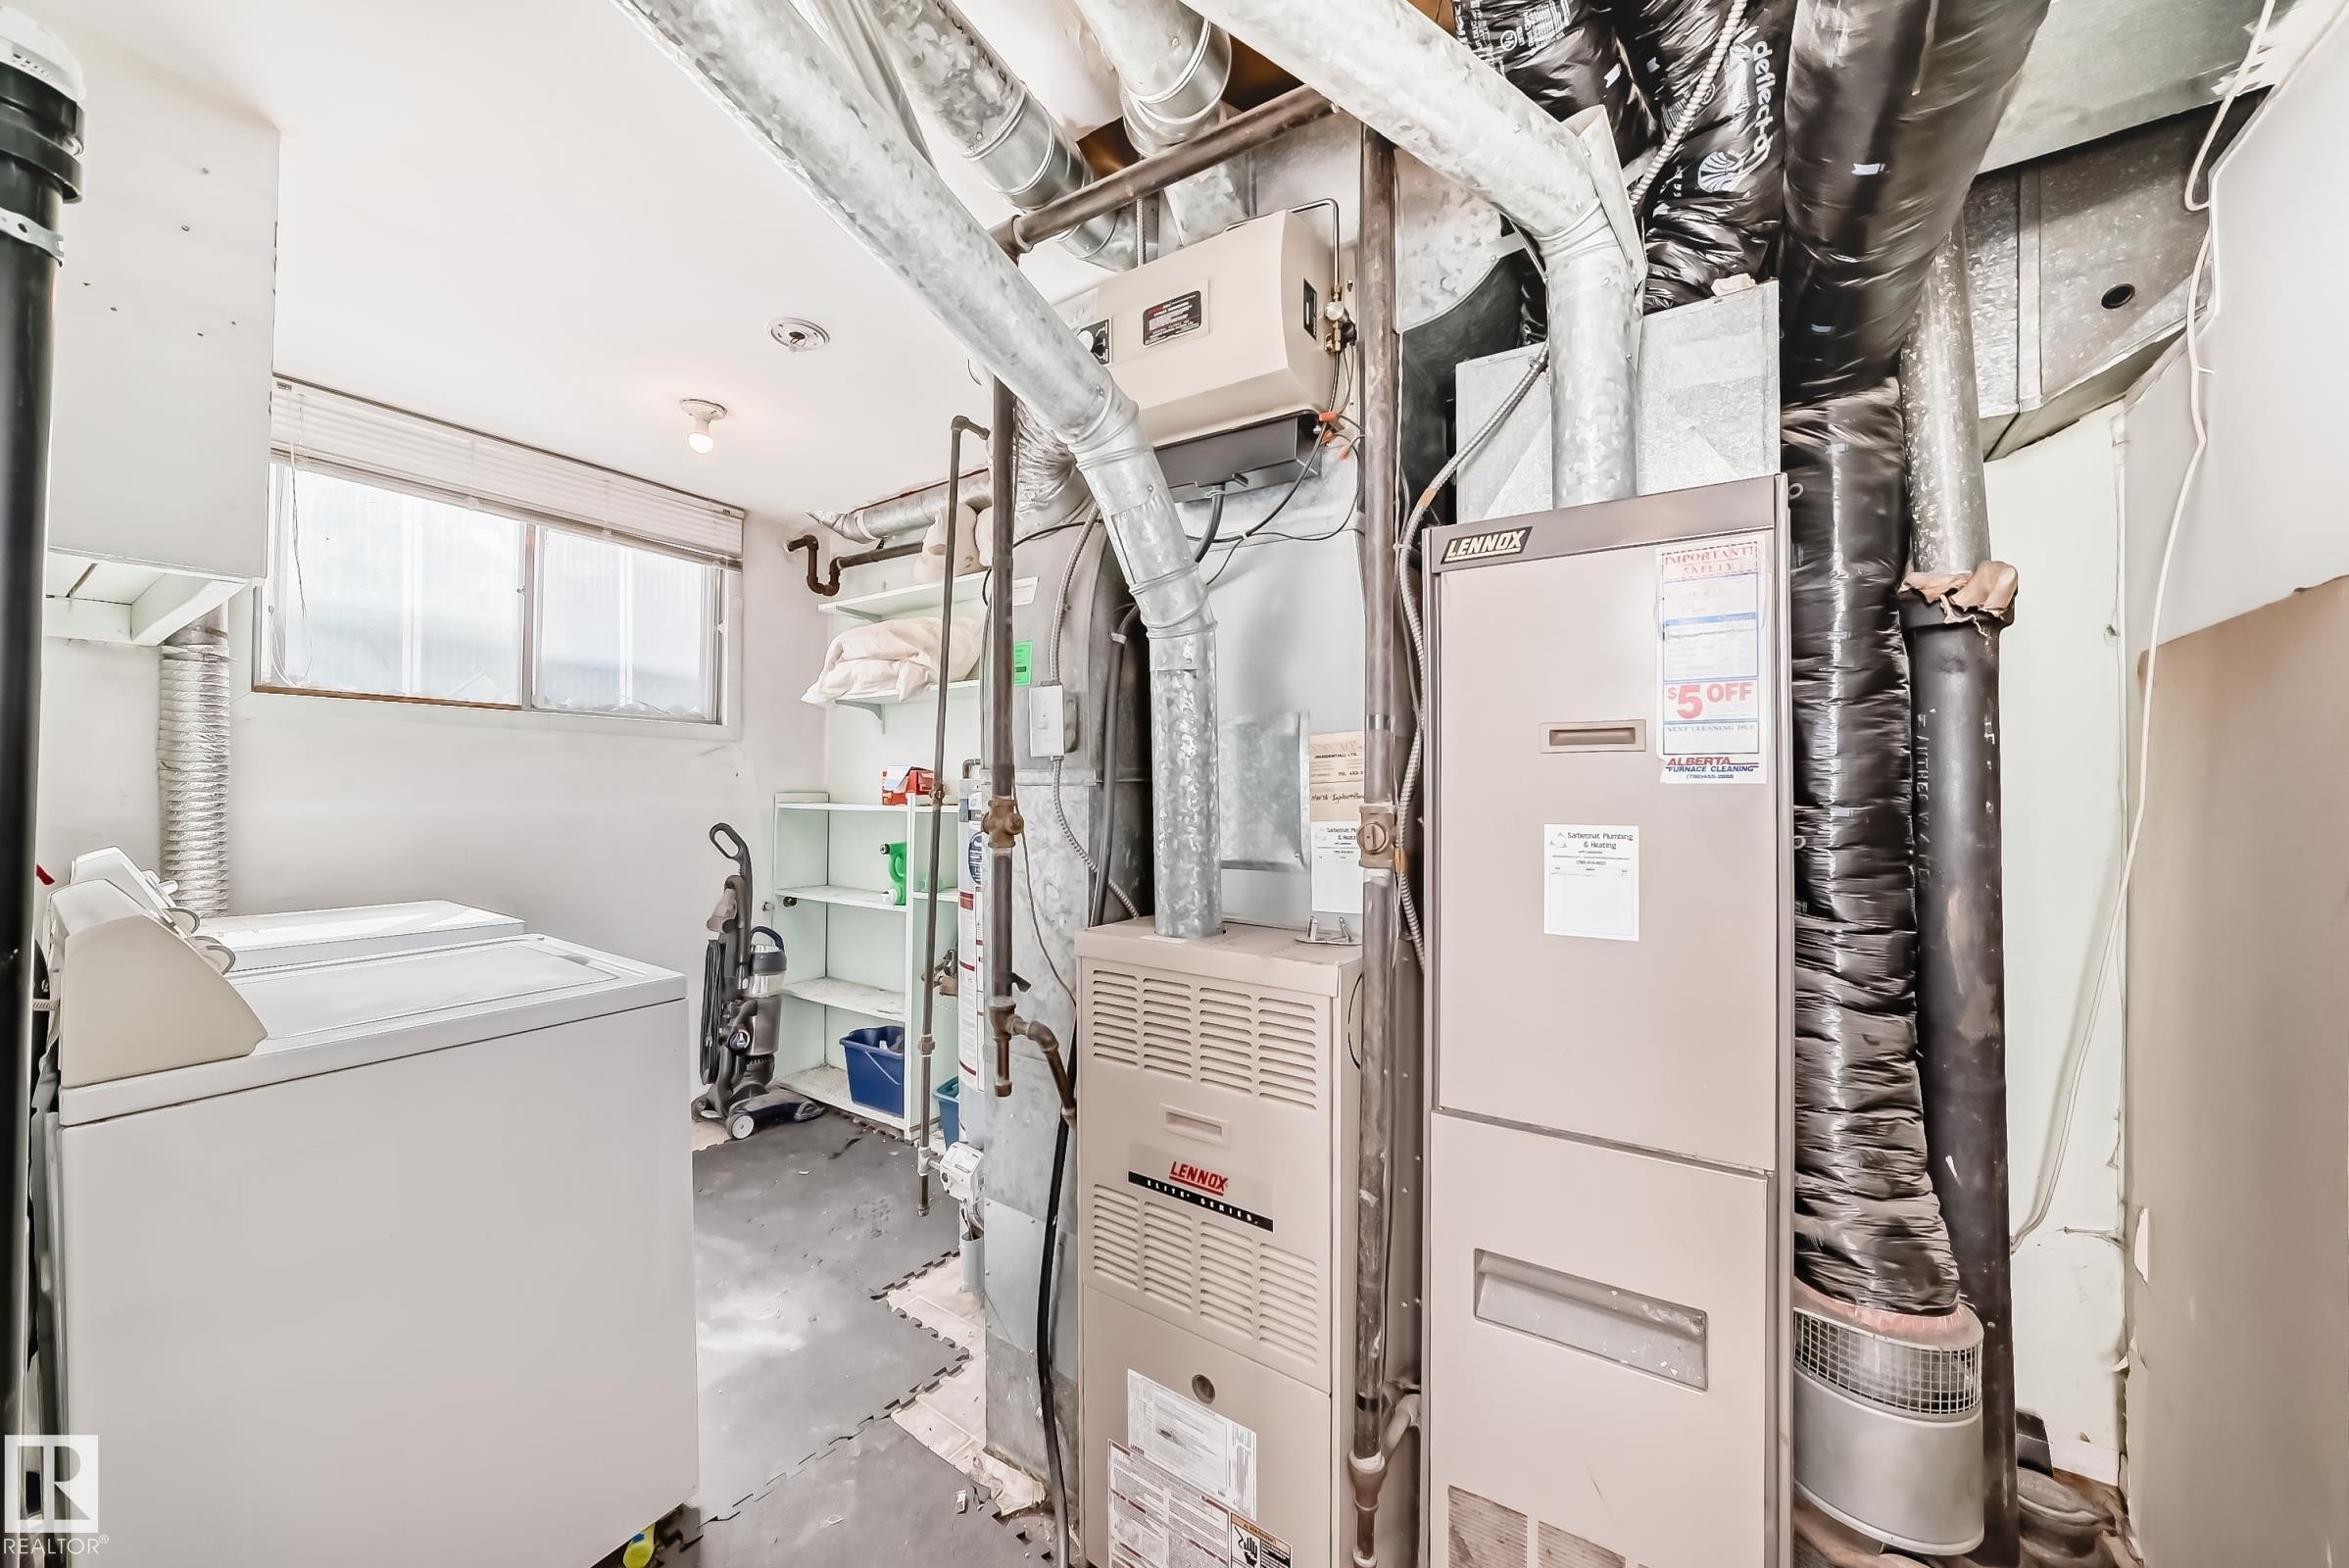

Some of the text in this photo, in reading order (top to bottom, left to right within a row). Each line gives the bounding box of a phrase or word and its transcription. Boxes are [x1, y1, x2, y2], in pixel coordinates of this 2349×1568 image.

[1445, 529, 1526, 559] LENNOX
[1667, 683, 1703, 719] $5
[1706, 681, 1754, 703] OFF
[1667, 757, 1732, 766] ALBERTA
[1171, 1161, 1228, 1192] LENNOX
